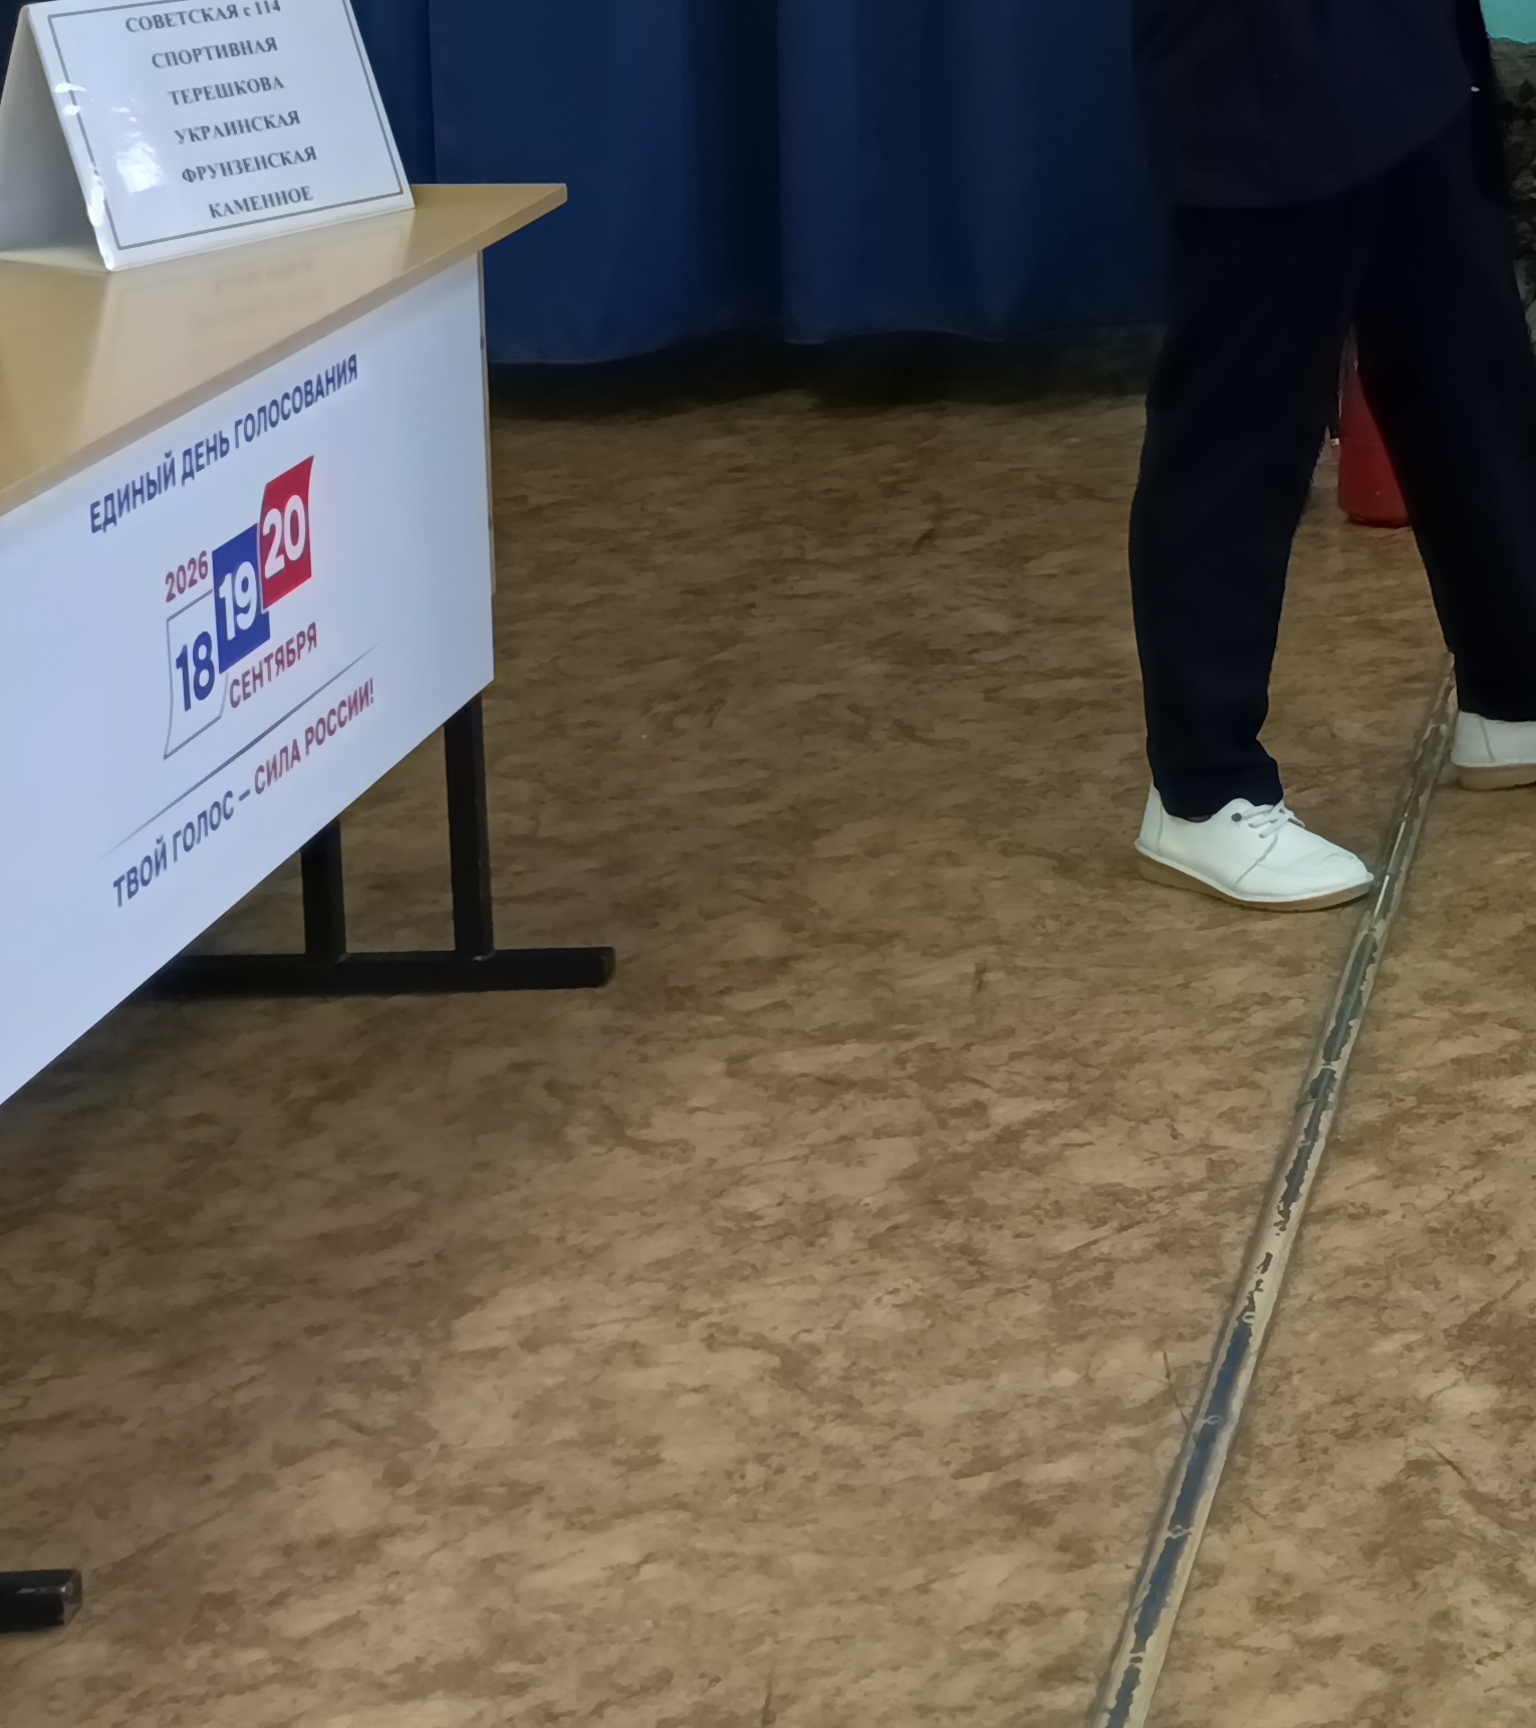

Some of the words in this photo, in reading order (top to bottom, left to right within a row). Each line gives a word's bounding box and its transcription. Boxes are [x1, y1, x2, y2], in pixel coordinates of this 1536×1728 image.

[125, 4, 239, 33] СОВЕТСКАЯ
[254, 0, 281, 15] 114
[151, 36, 279, 69] СПОРТИВНАЯ
[167, 76, 285, 106] ТЕРЕШКОВА
[174, 110, 301, 145] УКРАИНСКАЯ
[181, 146, 318, 183] ФРУНЗЕНСКАЯ
[208, 186, 314, 219] КАМЕННОЕ
[90, 450, 176, 533] ЕДИНЫЙ
[181, 430, 230, 486] ДЕНЬ
[234, 353, 358, 449] ГОЛОСОВАНИЯ
[165, 550, 209, 603] 2026
[175, 631, 215, 711] 18
[219, 561, 258, 641] 19
[262, 494, 306, 580] 20
[229, 622, 318, 709] СЕНТЯБРЯ
[113, 834, 167, 908] ТВОЙ
[173, 790, 234, 862] ГОЛОС
[254, 738, 301, 795] СИЛА
[304, 677, 375, 756] РОССИИ!
